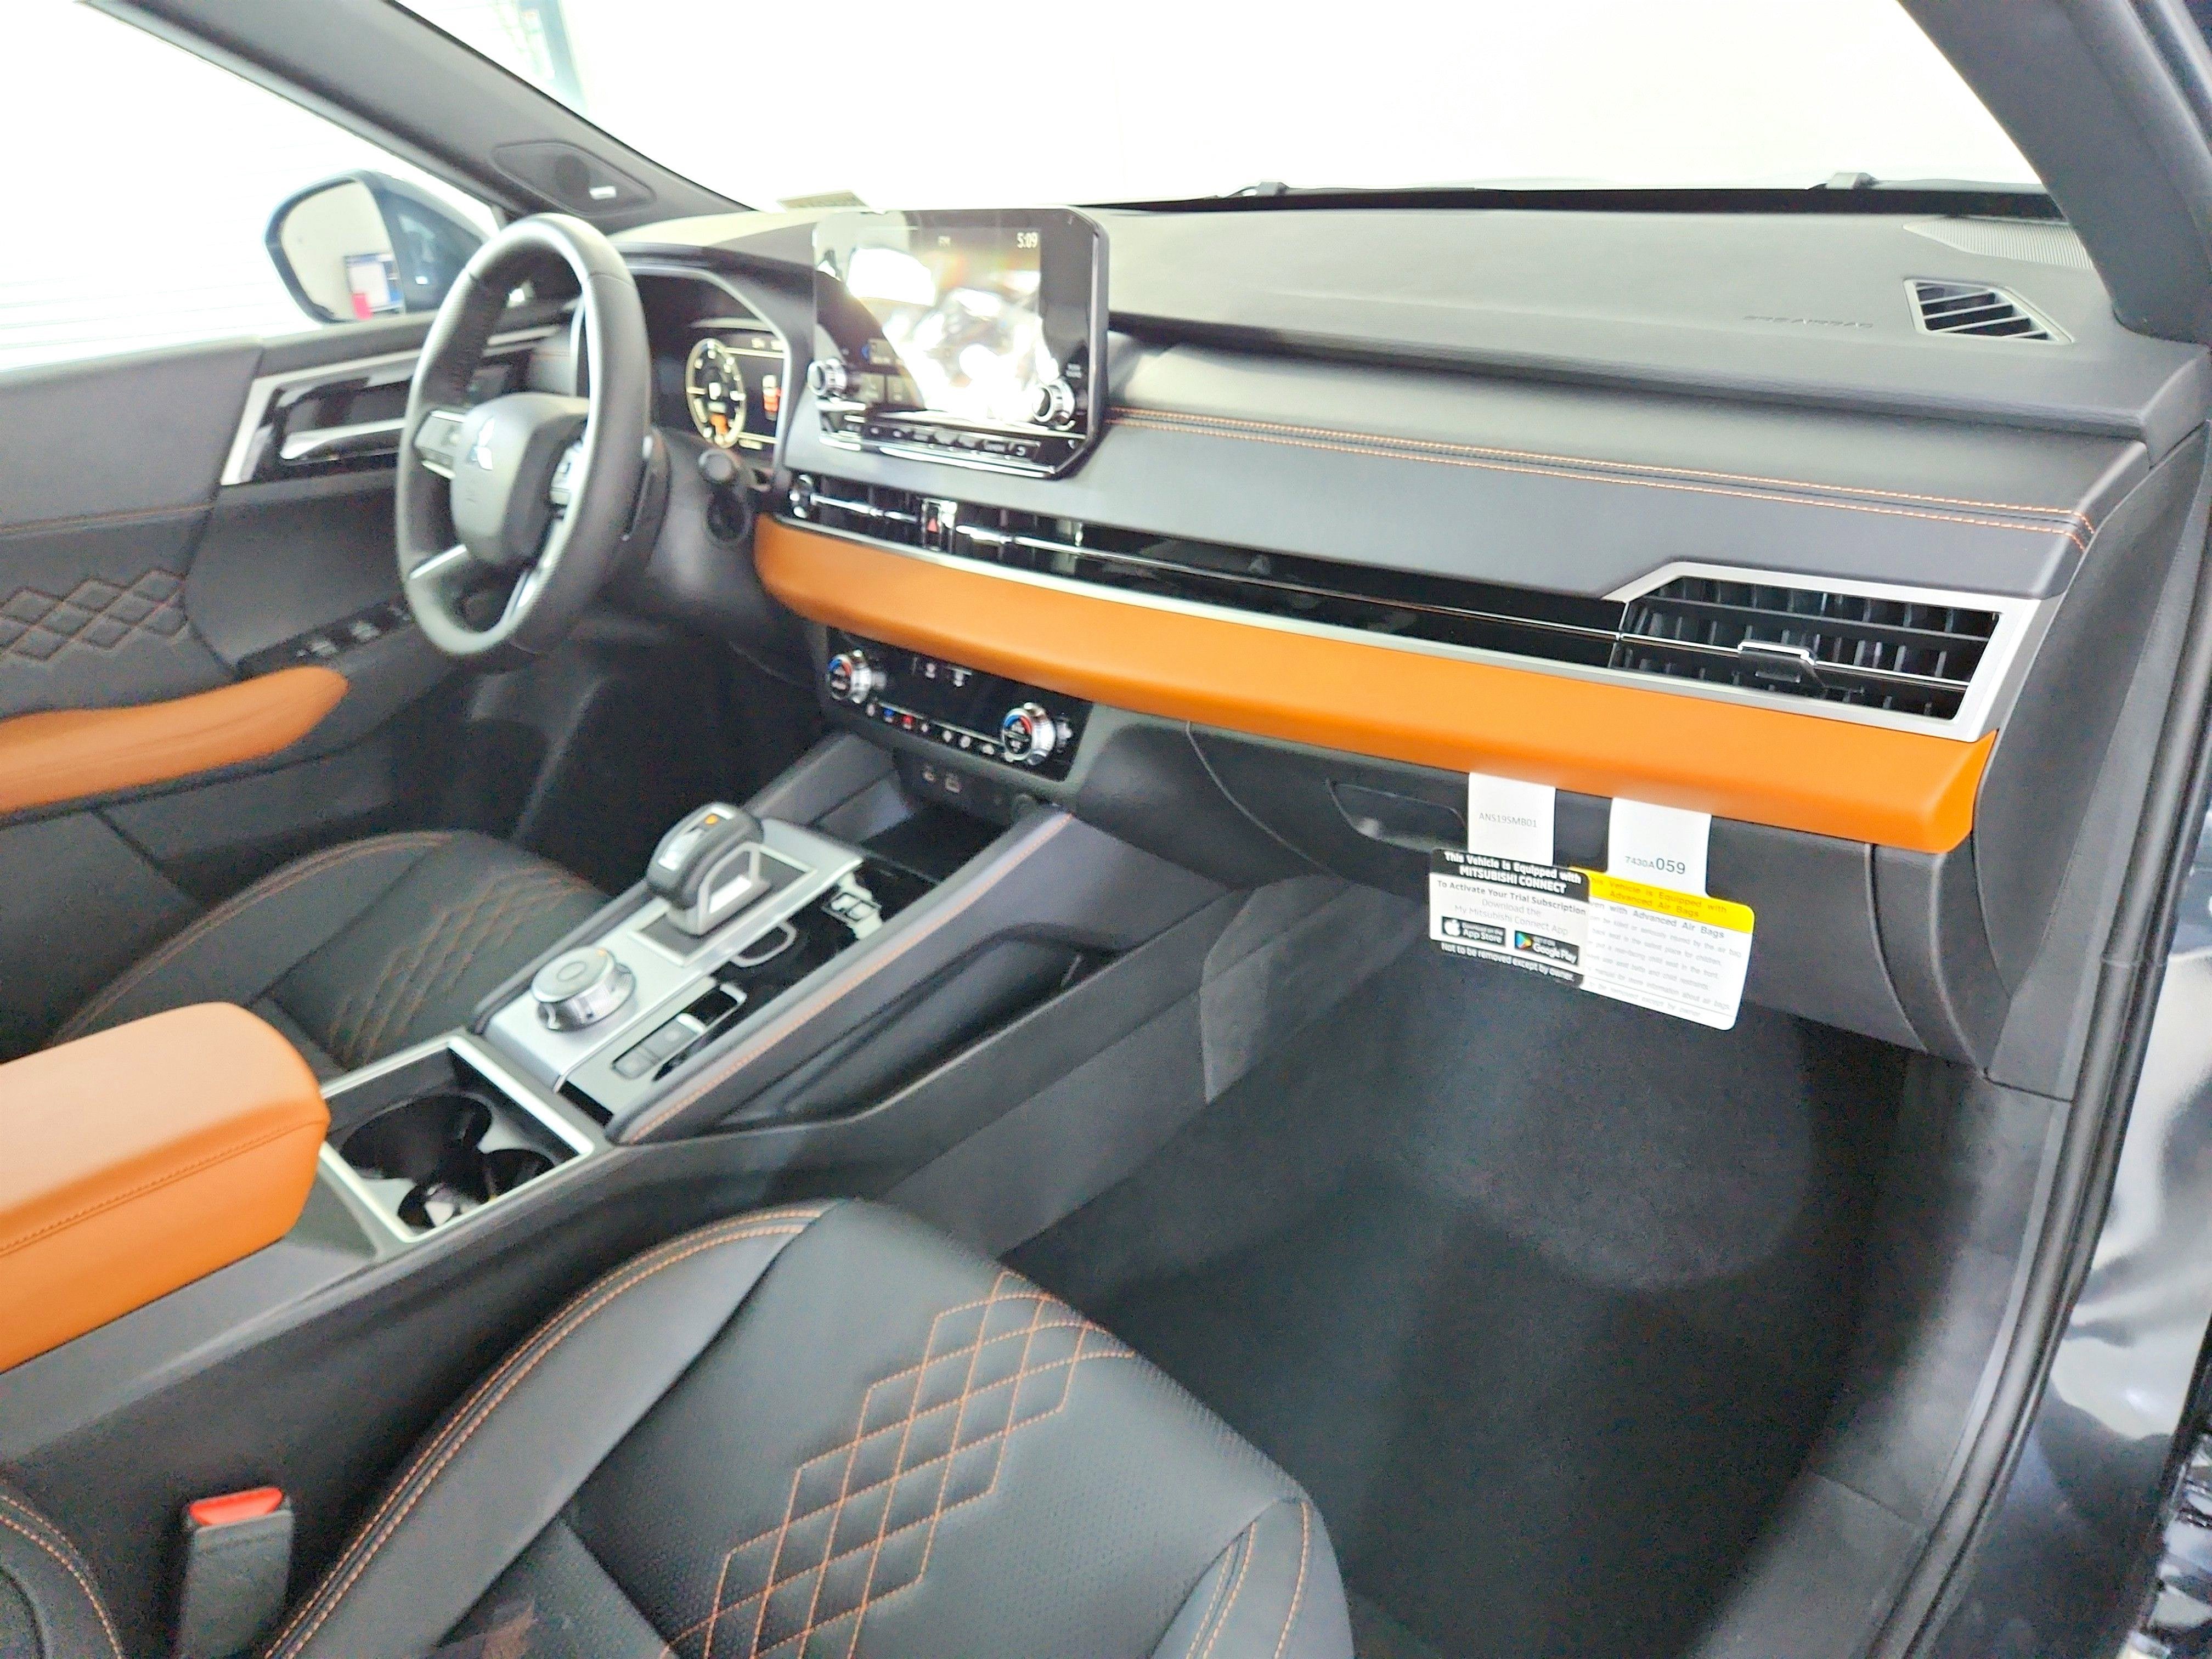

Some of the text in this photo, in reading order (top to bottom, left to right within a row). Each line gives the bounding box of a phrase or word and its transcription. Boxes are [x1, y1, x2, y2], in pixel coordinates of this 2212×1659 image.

[1017, 232, 1039, 249] 5:09
[1479, 812, 1537, 827] ANS19SMB01
[1444, 851, 1582, 885] This Vehicle is Equipped with
[1459, 865, 1567, 894] MITSUBISHI CONNECT
[1449, 882, 1486, 894] Activate
[1488, 888, 1508, 898] Your
[1509, 893, 1530, 903] Trial
[1531, 896, 1586, 916] Subscription
[1482, 899, 1541, 916] Download the
[1589, 877, 1604, 885] his
[1610, 880, 1640, 894] Vehicle
[1658, 891, 1702, 908] Equipped
[1707, 904, 1727, 913] with
[1610, 890, 1700, 918] Advanced Air Bags
[1454, 904, 1568, 936] My Mitsubishi Connect App
[1610, 905, 1628, 915] with
[1633, 909, 1677, 927] Advanced
[1681, 922, 1695, 931] Air
[1701, 926, 1724, 939] Bags
[1463, 928, 1502, 944] App Store
[1441, 942, 1457, 953] Not
[1457, 945, 1465, 955] to
[1466, 946, 1477, 957] be
[1478, 950, 1512, 964] removed
[1513, 957, 1538, 972] except
[1538, 964, 1549, 975] by
[1532, 943, 1578, 964] Google Play
